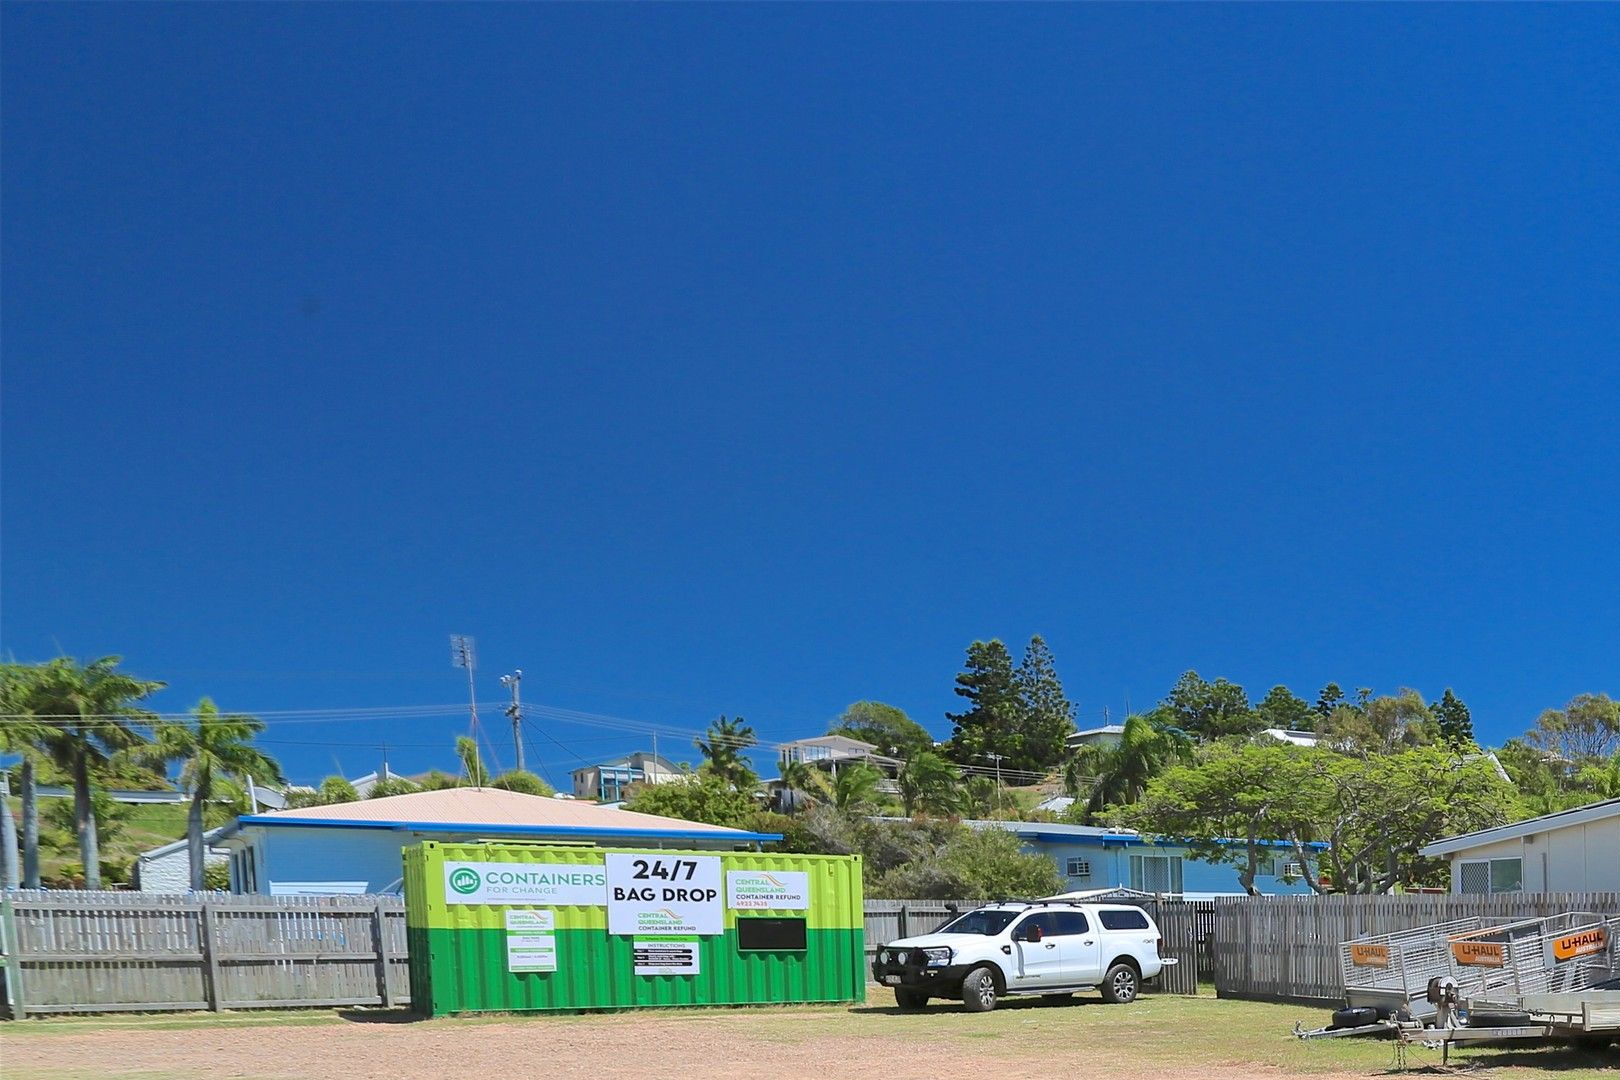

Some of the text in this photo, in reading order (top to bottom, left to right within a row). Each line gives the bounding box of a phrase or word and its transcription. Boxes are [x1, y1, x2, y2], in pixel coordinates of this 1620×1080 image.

[632, 860, 697, 881] 24/7
[486, 872, 606, 886] CONTAINERS
[486, 886, 505, 894] FOR
[614, 887, 717, 902] BAG DROP
[1562, 932, 1603, 950] U-HAUL
[1357, 946, 1385, 957] U-HAUL
[1462, 945, 1499, 955] U-HAUL
